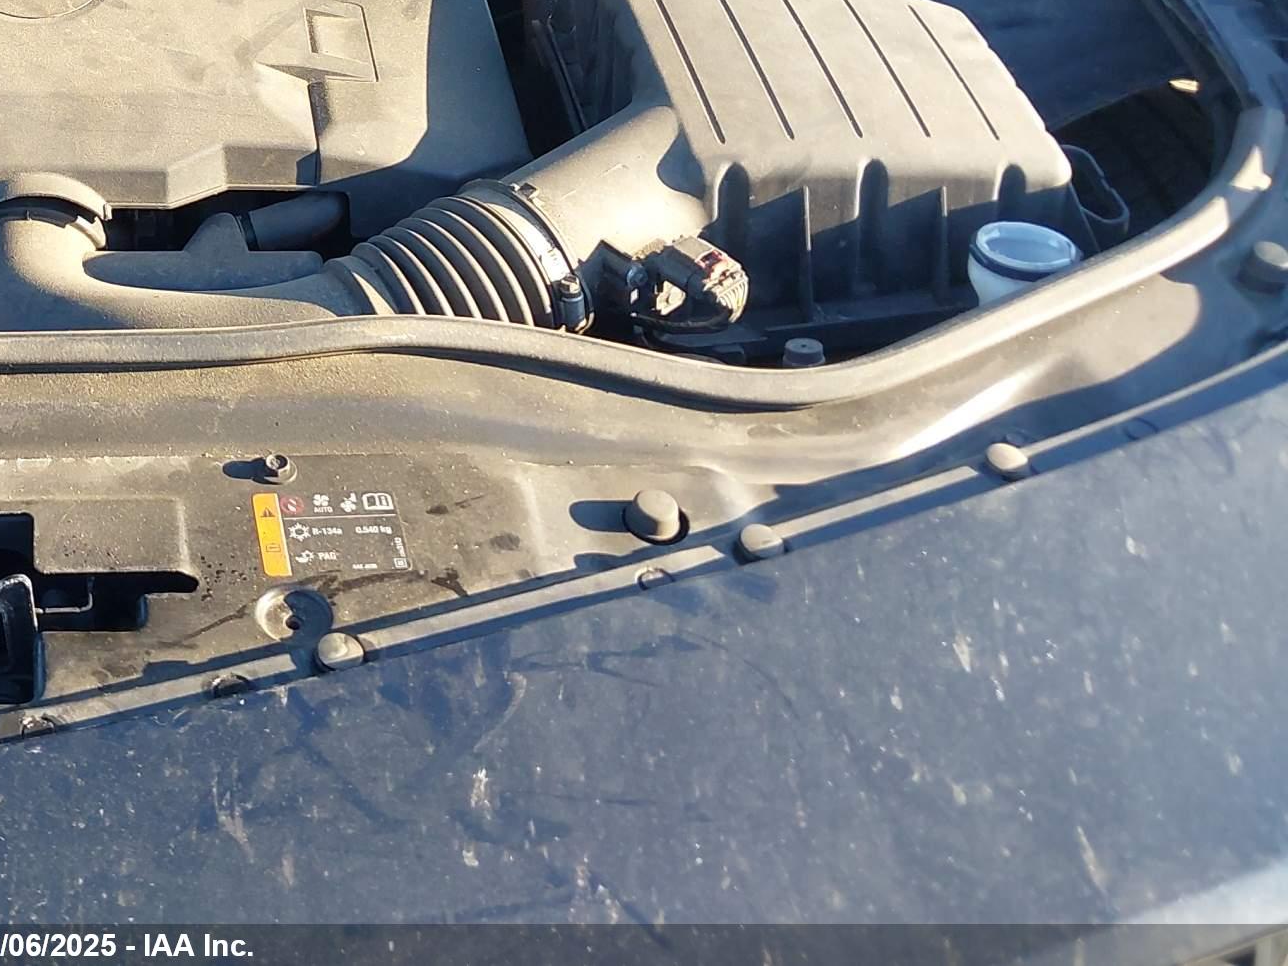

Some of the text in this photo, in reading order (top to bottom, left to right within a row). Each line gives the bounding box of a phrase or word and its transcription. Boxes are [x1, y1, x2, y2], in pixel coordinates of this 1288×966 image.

[313, 506, 333, 514] AUTO
[312, 527, 343, 536] R-134a
[380, 525, 392, 535] kg
[318, 551, 338, 561] PAG
